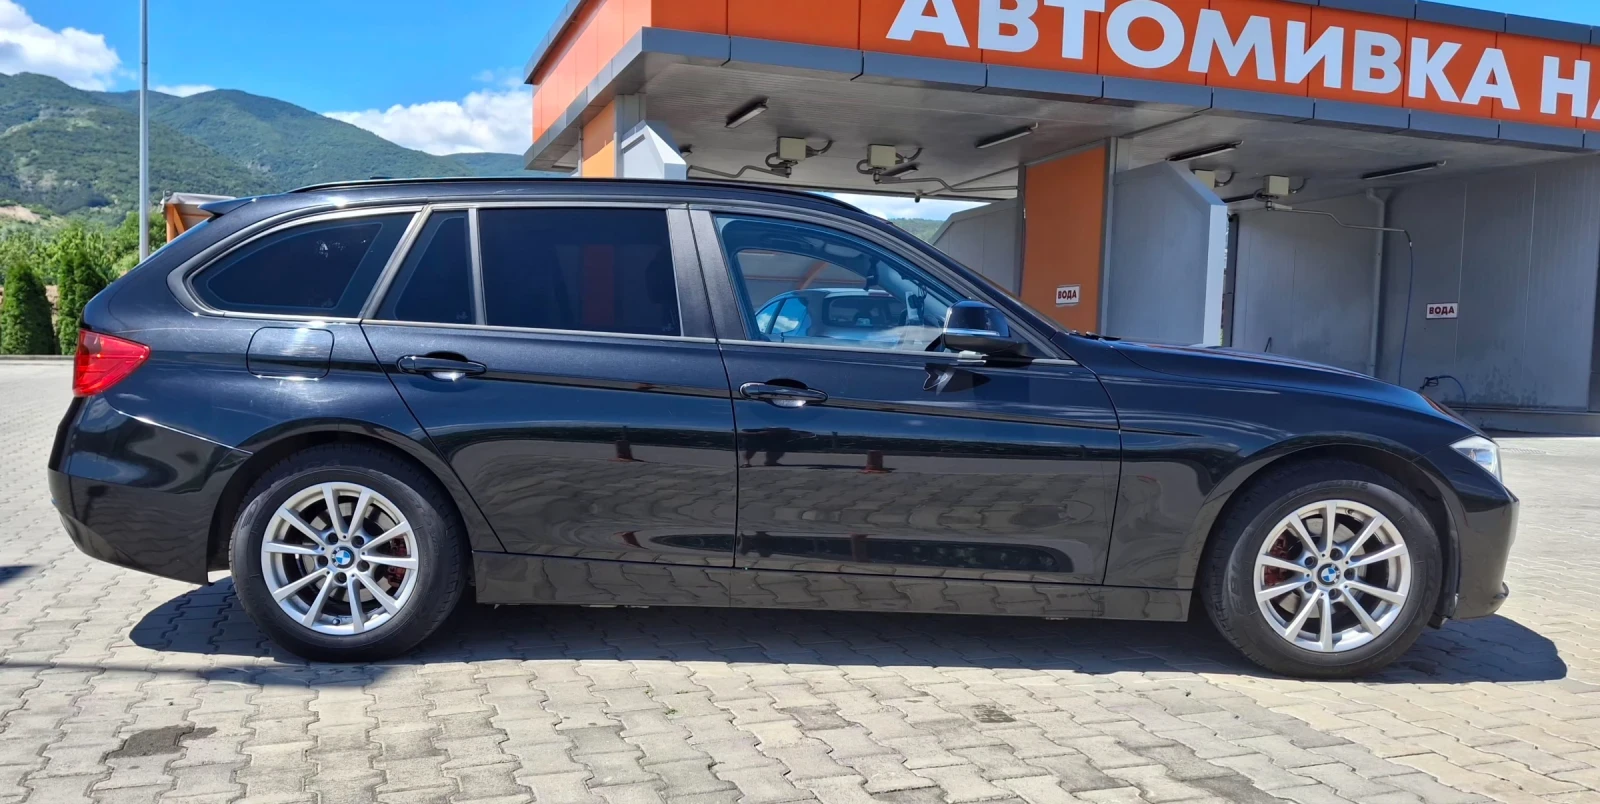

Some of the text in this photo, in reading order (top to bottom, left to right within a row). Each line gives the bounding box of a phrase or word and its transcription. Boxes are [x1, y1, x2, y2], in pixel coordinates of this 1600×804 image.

[886, 0, 1600, 119] АВТОМИВКА Н
[1057, 289, 1077, 300] ВОДА
[1428, 306, 1455, 315] ВОДА
